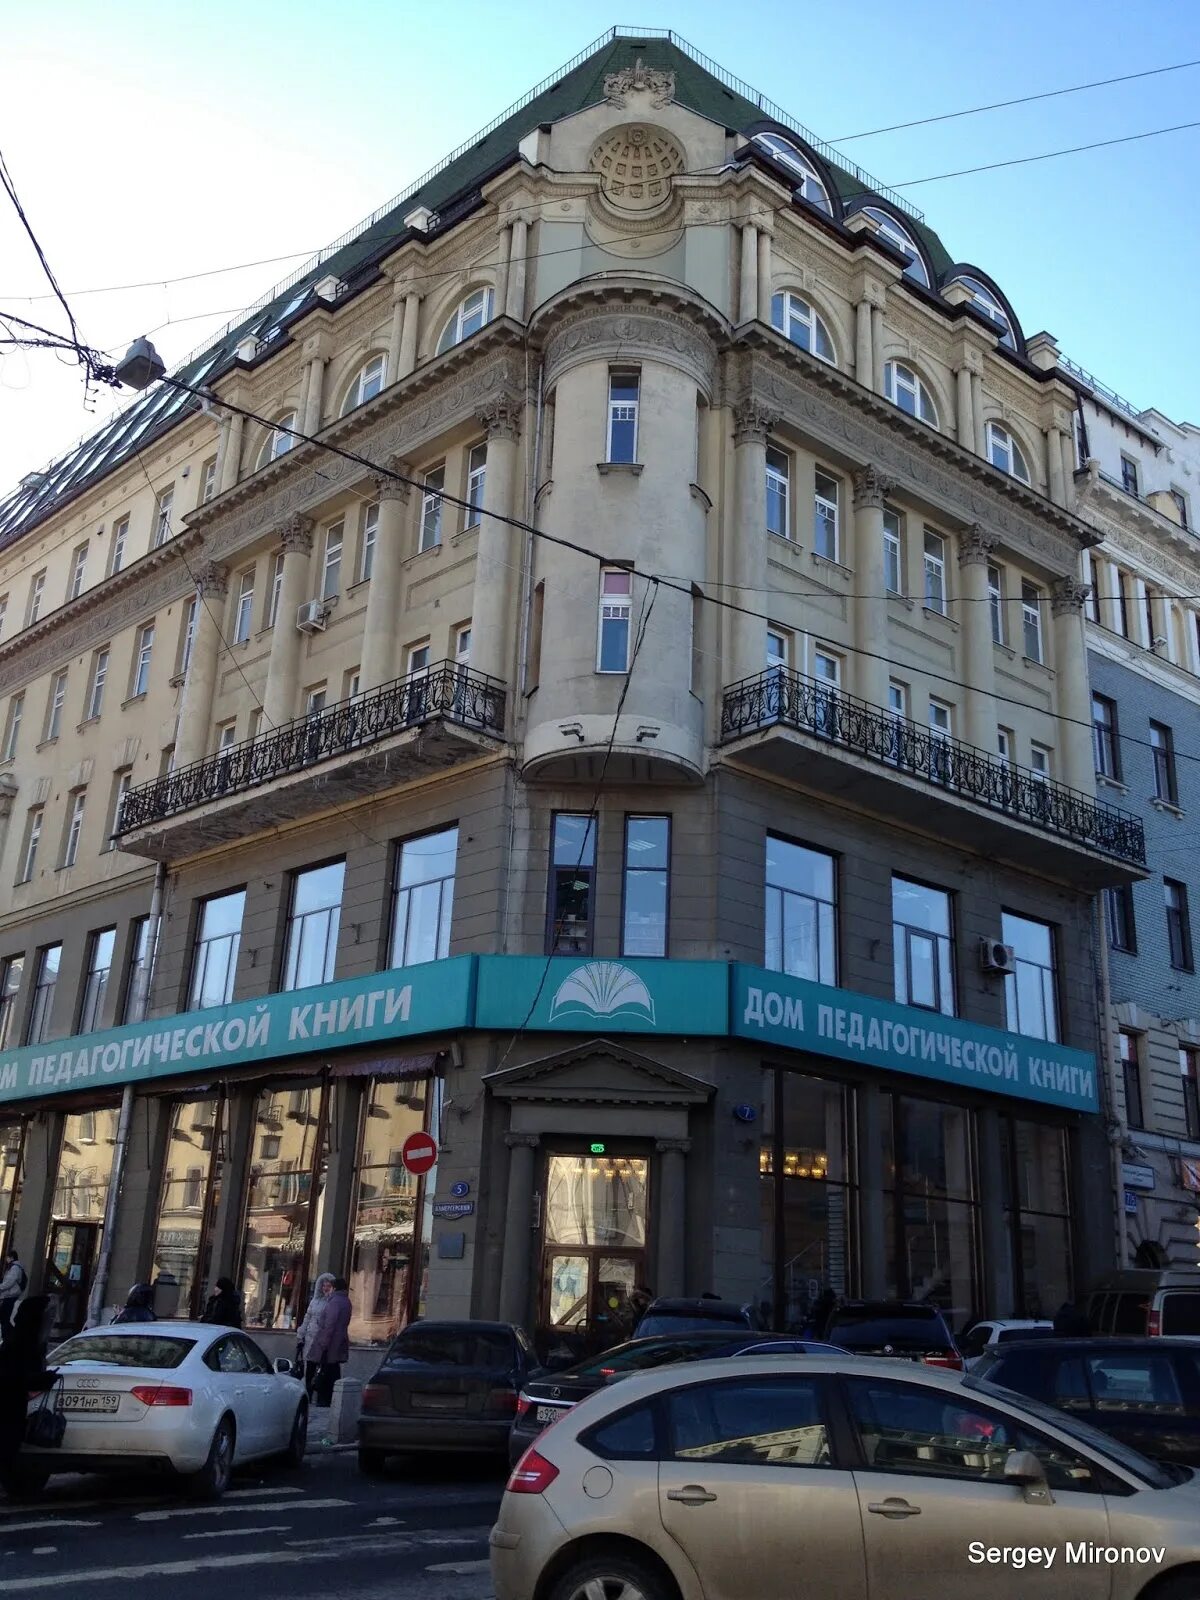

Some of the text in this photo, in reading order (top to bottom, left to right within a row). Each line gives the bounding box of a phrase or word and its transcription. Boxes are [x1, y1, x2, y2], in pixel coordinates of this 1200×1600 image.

[27, 1003, 271, 1086] ПЕДАГОГИЧЕСКОЙ
[288, 984, 412, 1041] КНИГИ
[743, 986, 1094, 1099] ДОМ ПЕДАГОГИЧЕСКОЙ КНИГИ
[101, 1396, 117, 1405] 159
